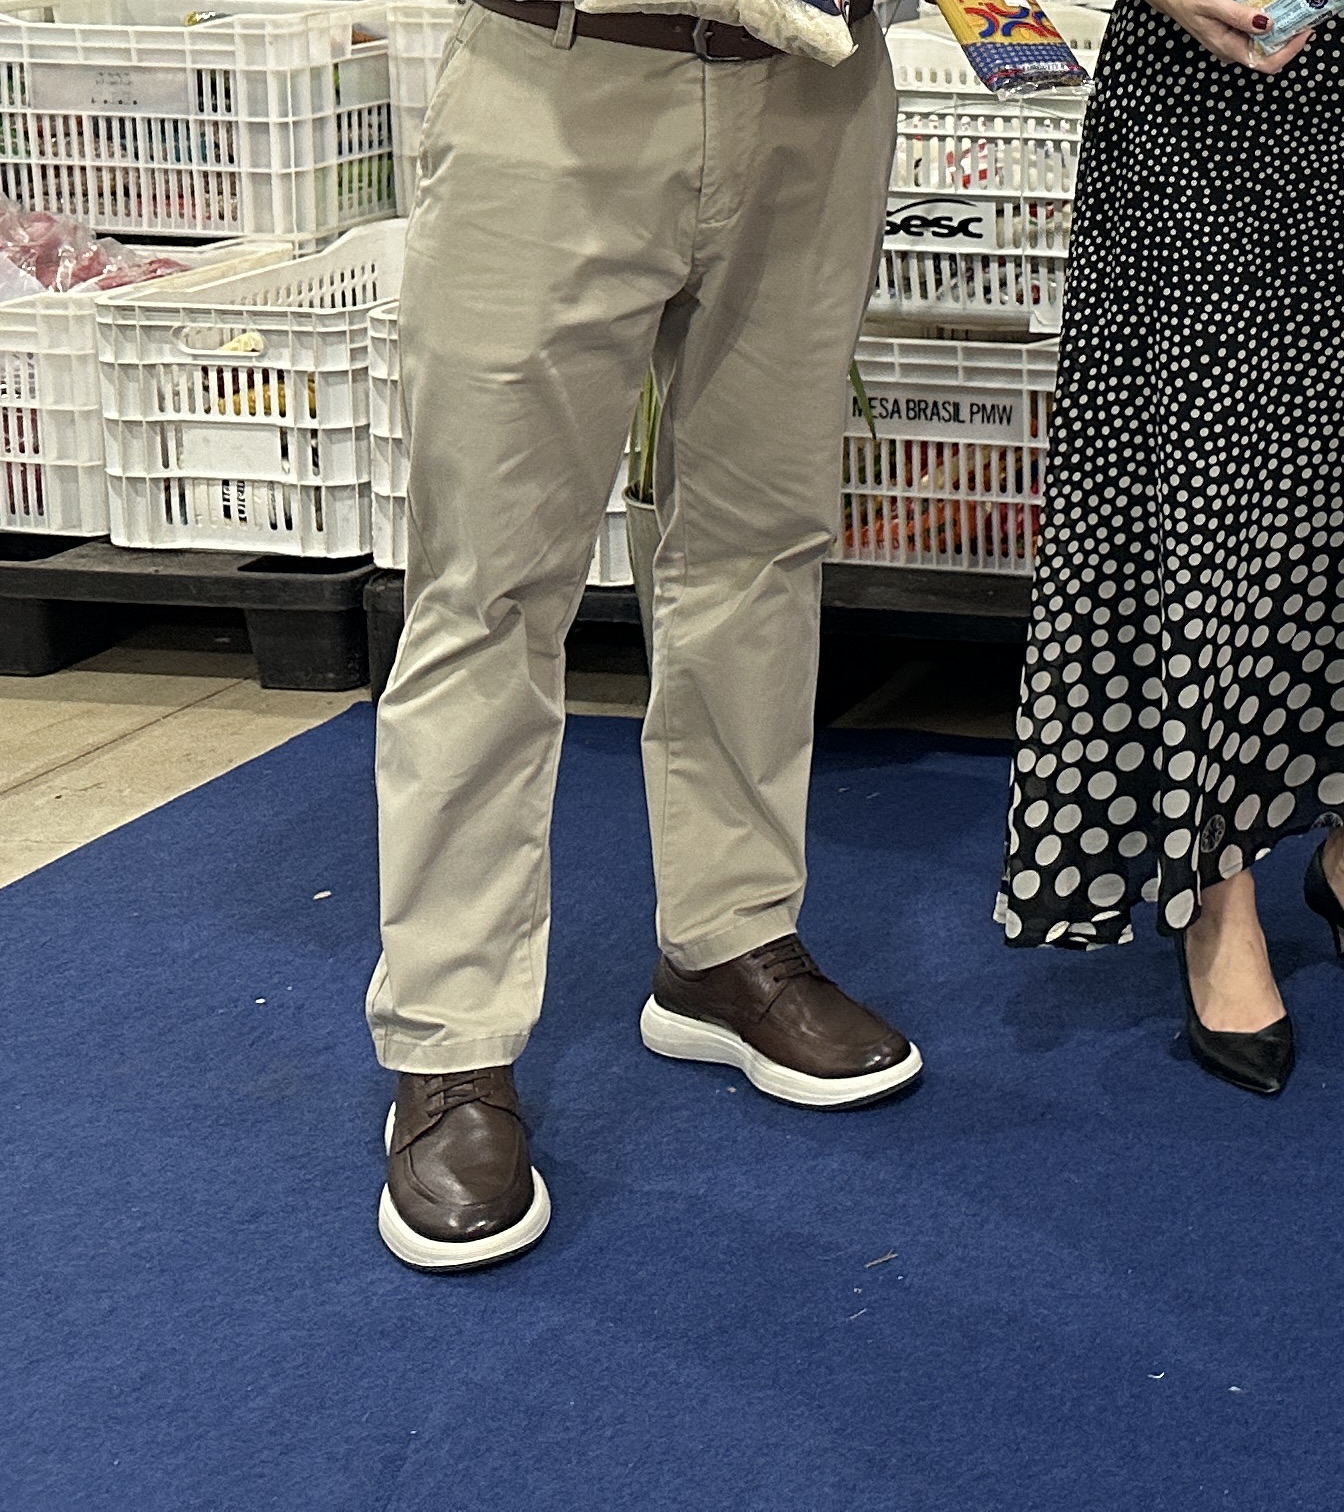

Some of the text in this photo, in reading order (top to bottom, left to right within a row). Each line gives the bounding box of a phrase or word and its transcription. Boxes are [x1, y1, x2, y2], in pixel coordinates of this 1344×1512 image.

[851, 396, 1014, 426] MESA BRASIL PMW
